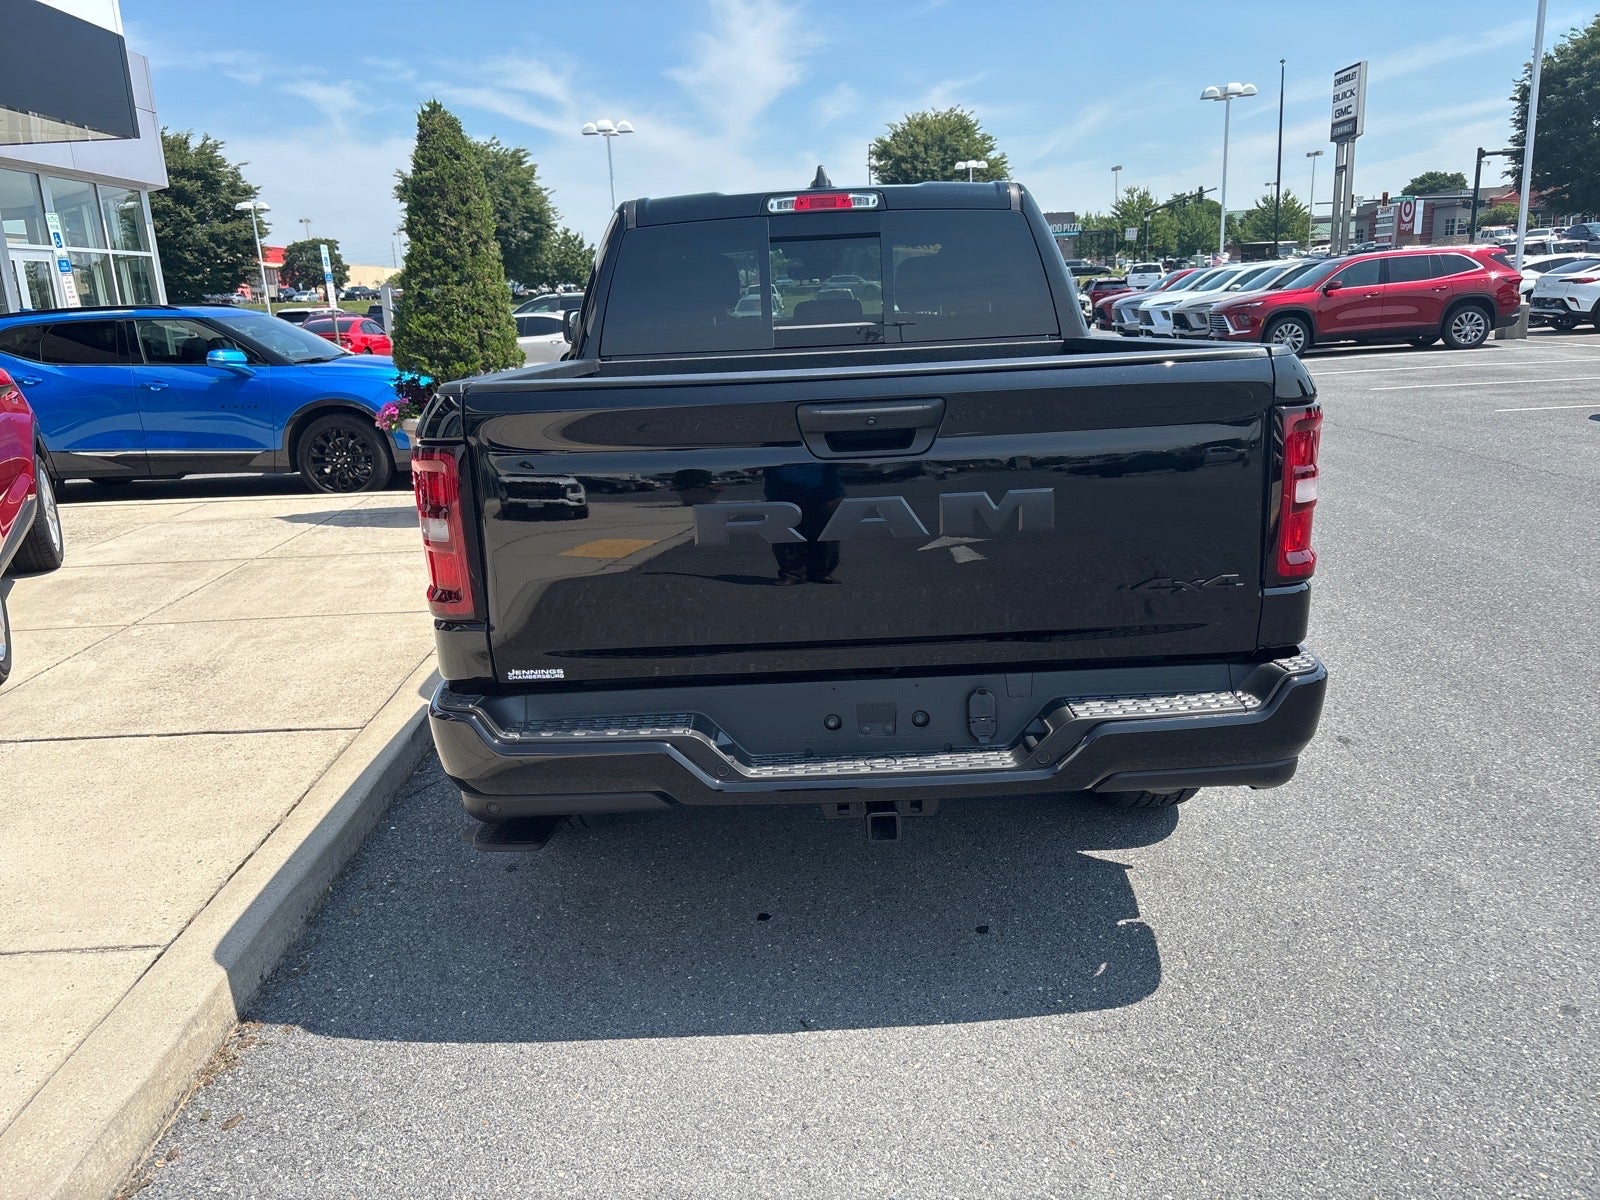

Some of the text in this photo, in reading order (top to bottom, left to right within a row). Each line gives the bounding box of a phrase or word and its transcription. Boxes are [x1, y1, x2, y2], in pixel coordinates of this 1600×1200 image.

[1334, 71, 1357, 87] CHEVROLET
[1333, 88, 1356, 103] BUICK
[1334, 105, 1352, 119] GMC
[1333, 124, 1353, 135] JENNINGS
[1063, 223, 1082, 232] PIZZA
[694, 487, 1054, 546] RAM
